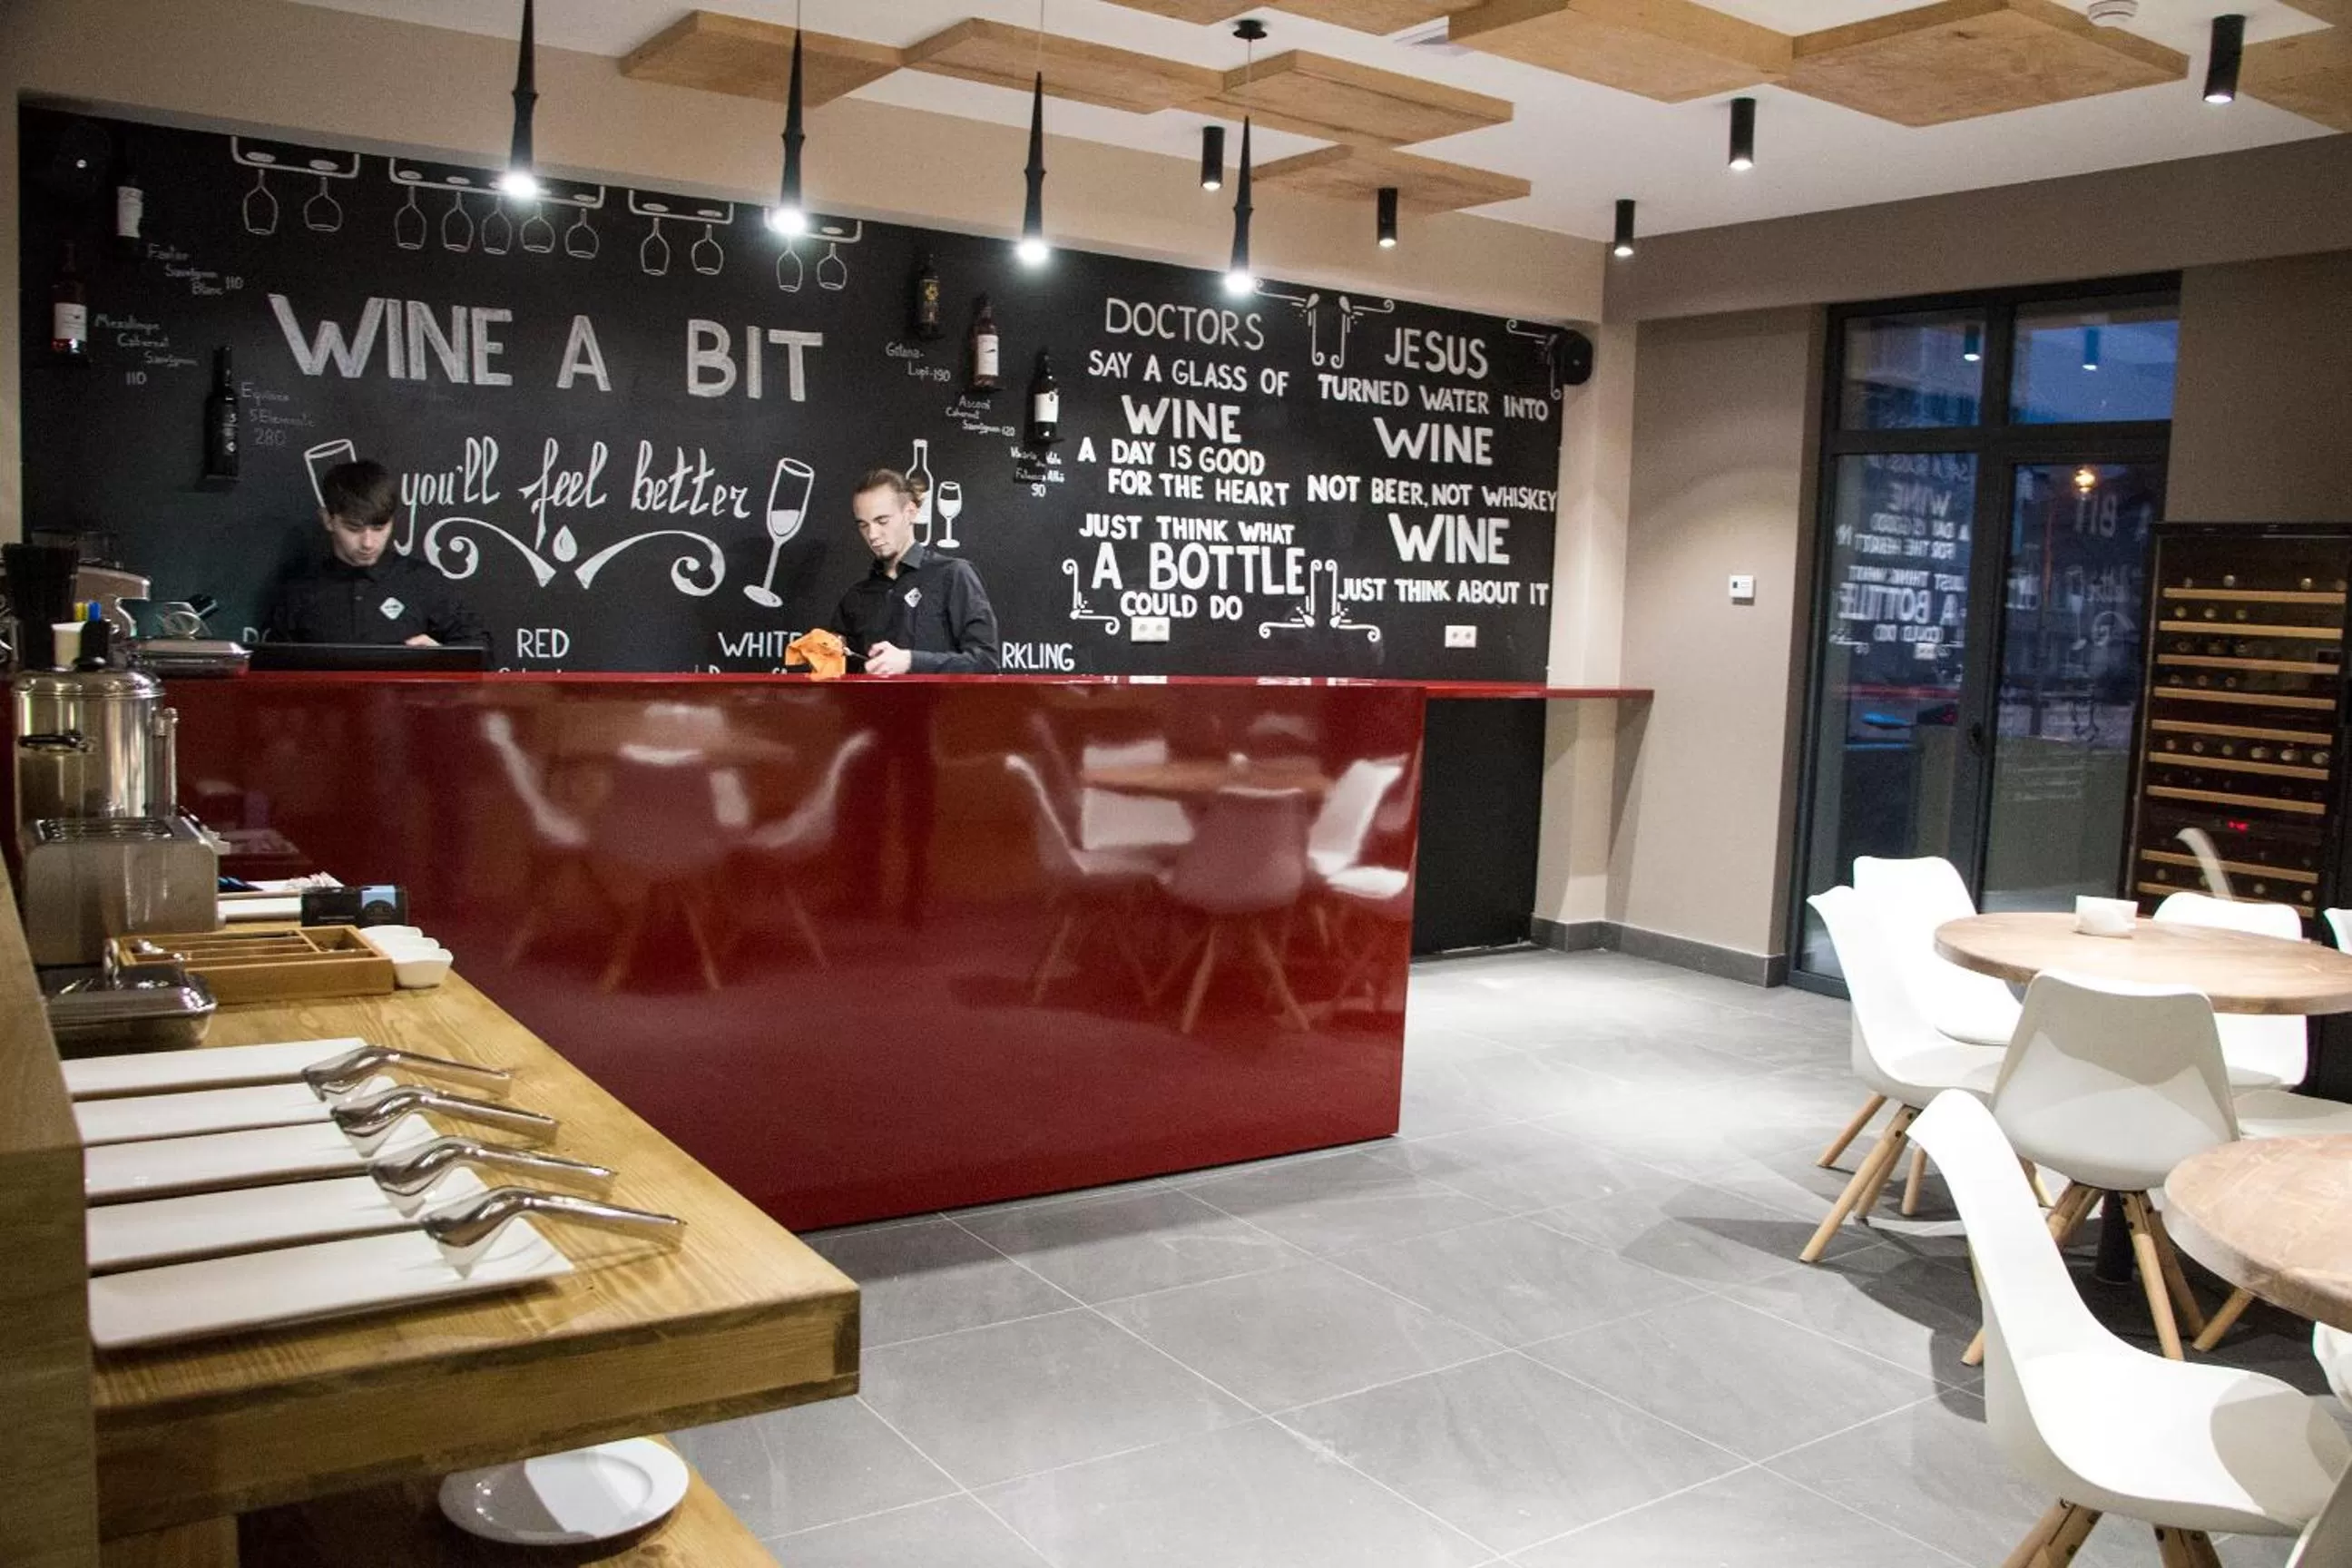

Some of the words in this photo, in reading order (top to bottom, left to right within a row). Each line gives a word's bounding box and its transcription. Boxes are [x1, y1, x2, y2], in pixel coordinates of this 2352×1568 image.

[225, 276, 244, 290] 110
[1105, 298, 1264, 351] DOCTORS
[269, 293, 514, 387] WINE
[556, 315, 612, 392] A
[687, 318, 823, 402] BIT
[1385, 327, 1488, 378] JESUS
[126, 371, 148, 386] 110
[1088, 350, 1132, 378] SAY
[1144, 354, 1162, 383] A
[1172, 359, 1248, 392] GLASS
[1260, 368, 1289, 397] OF
[1318, 373, 1409, 406] TURNED
[1419, 386, 1490, 415] WATER
[1503, 394, 1549, 421] INTO
[1121, 395, 1241, 444] WINE
[1077, 436, 1097, 463] A
[1112, 438, 1155, 465] DAY
[1170, 445, 1193, 470] IS
[1199, 446, 1266, 475] GOOD
[1373, 416, 1494, 466] WINE
[393, 436, 502, 557] you'll
[518, 437, 609, 552] feel
[632, 440, 750, 518] better
[1031, 483, 1047, 498] 90
[1109, 468, 1152, 496] FOR
[1159, 473, 1204, 499] THE
[1216, 478, 1290, 507] HEART
[1307, 474, 1361, 503] NOT
[1371, 476, 1429, 507] BEER,
[1431, 483, 1474, 506] NOT
[1482, 485, 1558, 513] WHISKEY
[1078, 513, 1143, 540] JUST
[1155, 514, 1229, 543] THINK
[1238, 520, 1296, 545] WHAT
[1387, 513, 1510, 565] WINE
[1091, 541, 1123, 591] A
[1149, 541, 1306, 595] BOTTLE
[1120, 591, 1197, 618] COULD
[1210, 594, 1243, 621] DO
[1338, 578, 1387, 602] JUST
[1395, 578, 1452, 603] THINK
[1456, 580, 1521, 604] ABOUT
[1530, 583, 1549, 606] IT
[516, 628, 570, 659] RED
[1001, 641, 1075, 671] RKLING
